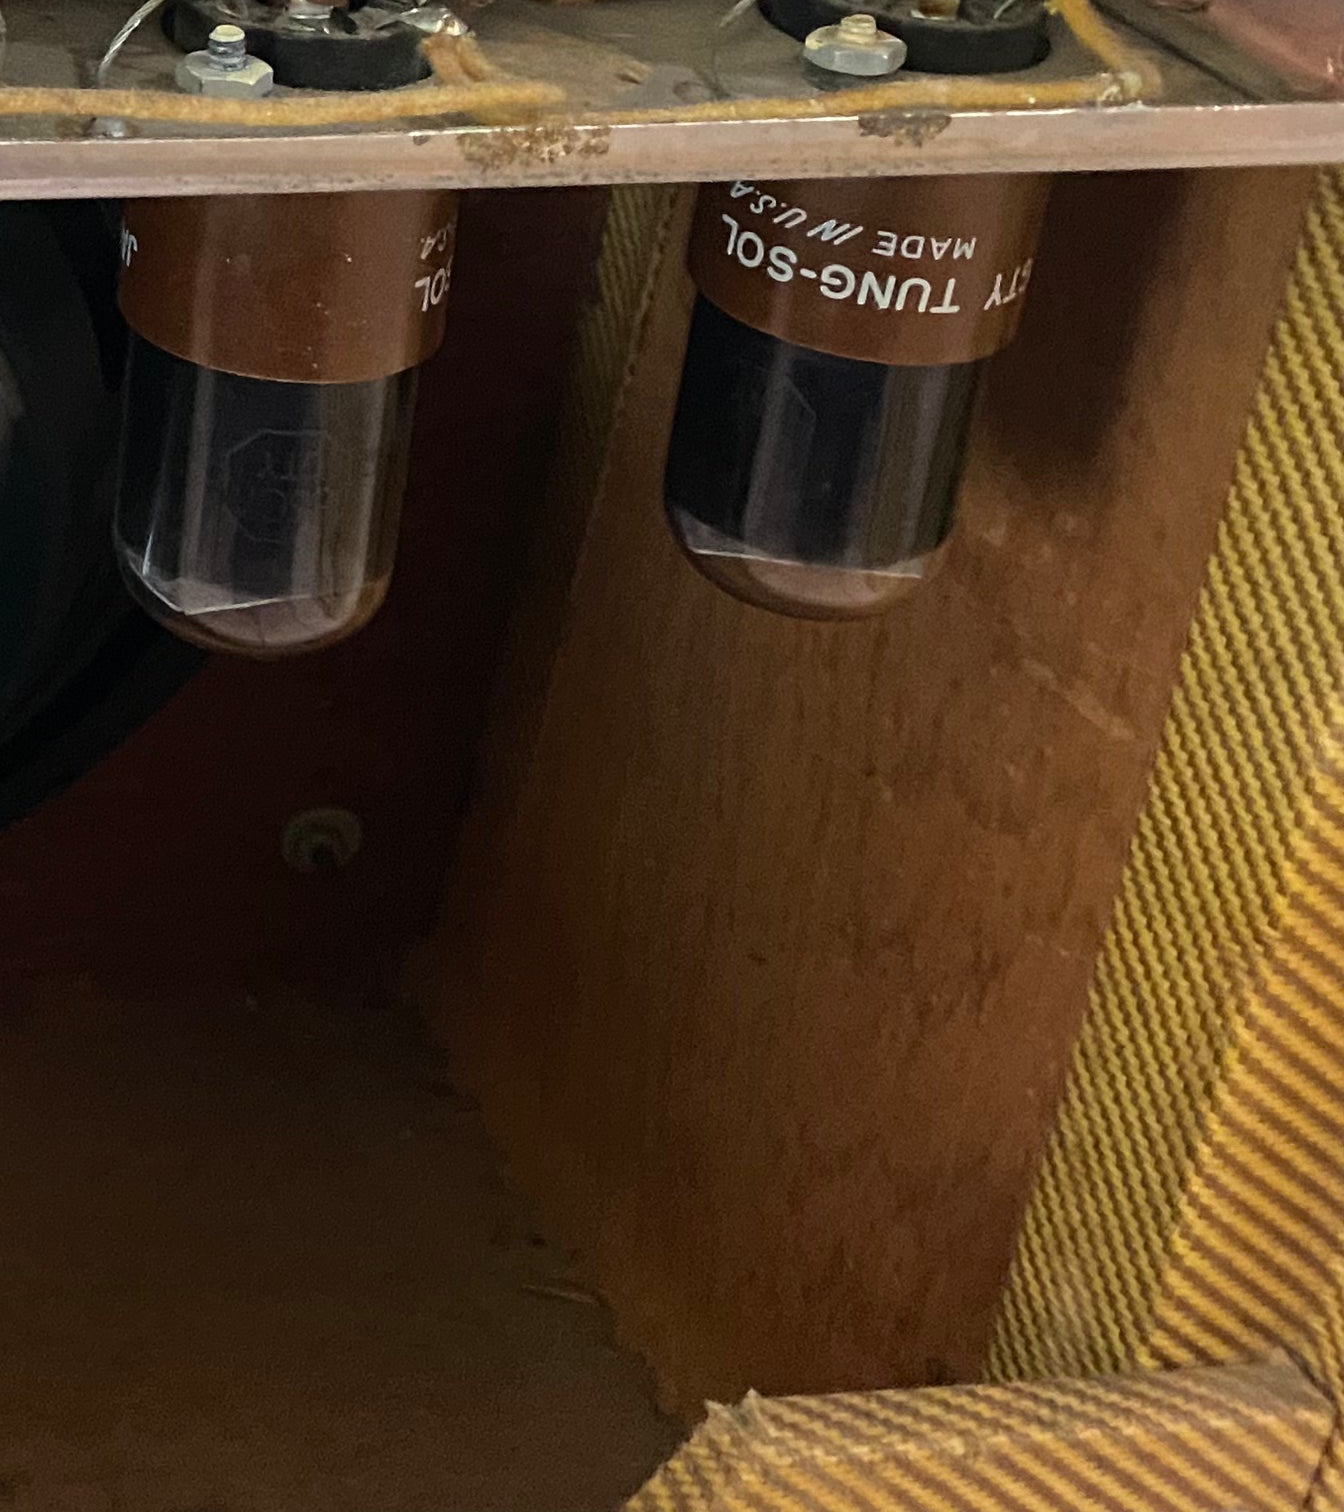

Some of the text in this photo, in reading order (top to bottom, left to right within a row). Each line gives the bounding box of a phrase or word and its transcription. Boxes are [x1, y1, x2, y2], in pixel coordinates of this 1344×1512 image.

[806, 219, 864, 246] IN
[871, 230, 976, 259] MADE
[721, 213, 961, 314] TUNG-SOL
